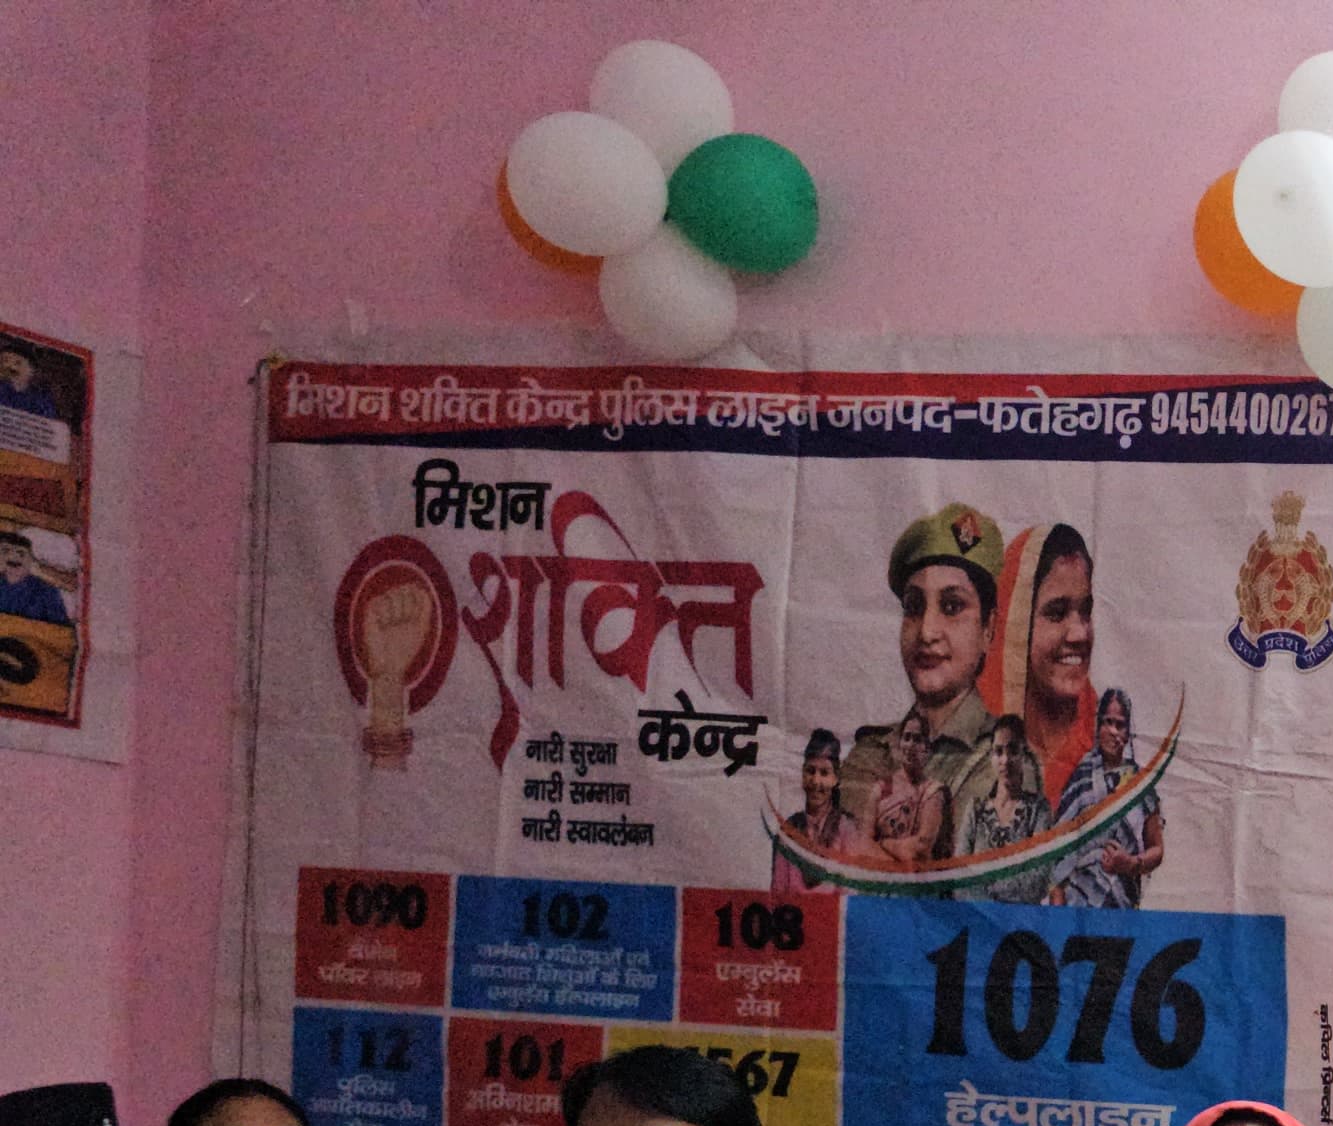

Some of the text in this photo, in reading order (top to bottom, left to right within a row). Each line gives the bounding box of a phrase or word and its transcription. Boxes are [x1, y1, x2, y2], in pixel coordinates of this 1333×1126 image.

[286, 373, 392, 421] मिशन
[402, 376, 498, 425] शक्ति
[506, 377, 593, 430] केन्द्र
[601, 377, 697, 441] पुलिस
[706, 387, 819, 437] लाइन
[412, 457, 551, 530] मिशन
[461, 491, 765, 776] शक्ति
[525, 730, 618, 777] नारी सुरक्षा
[637, 689, 768, 777] केन्द्र
[523, 770, 631, 806] नारी सम्मान
[521, 808, 563, 842] नारी
[320, 882, 429, 931] 1090
[521, 890, 610, 942] 102
[714, 901, 805, 951] 108
[737, 993, 783, 1018] सेवा
[925, 926, 1205, 1070] 1076
[325, 1025, 414, 1073] 112
[485, 1032, 566, 1082] 101
